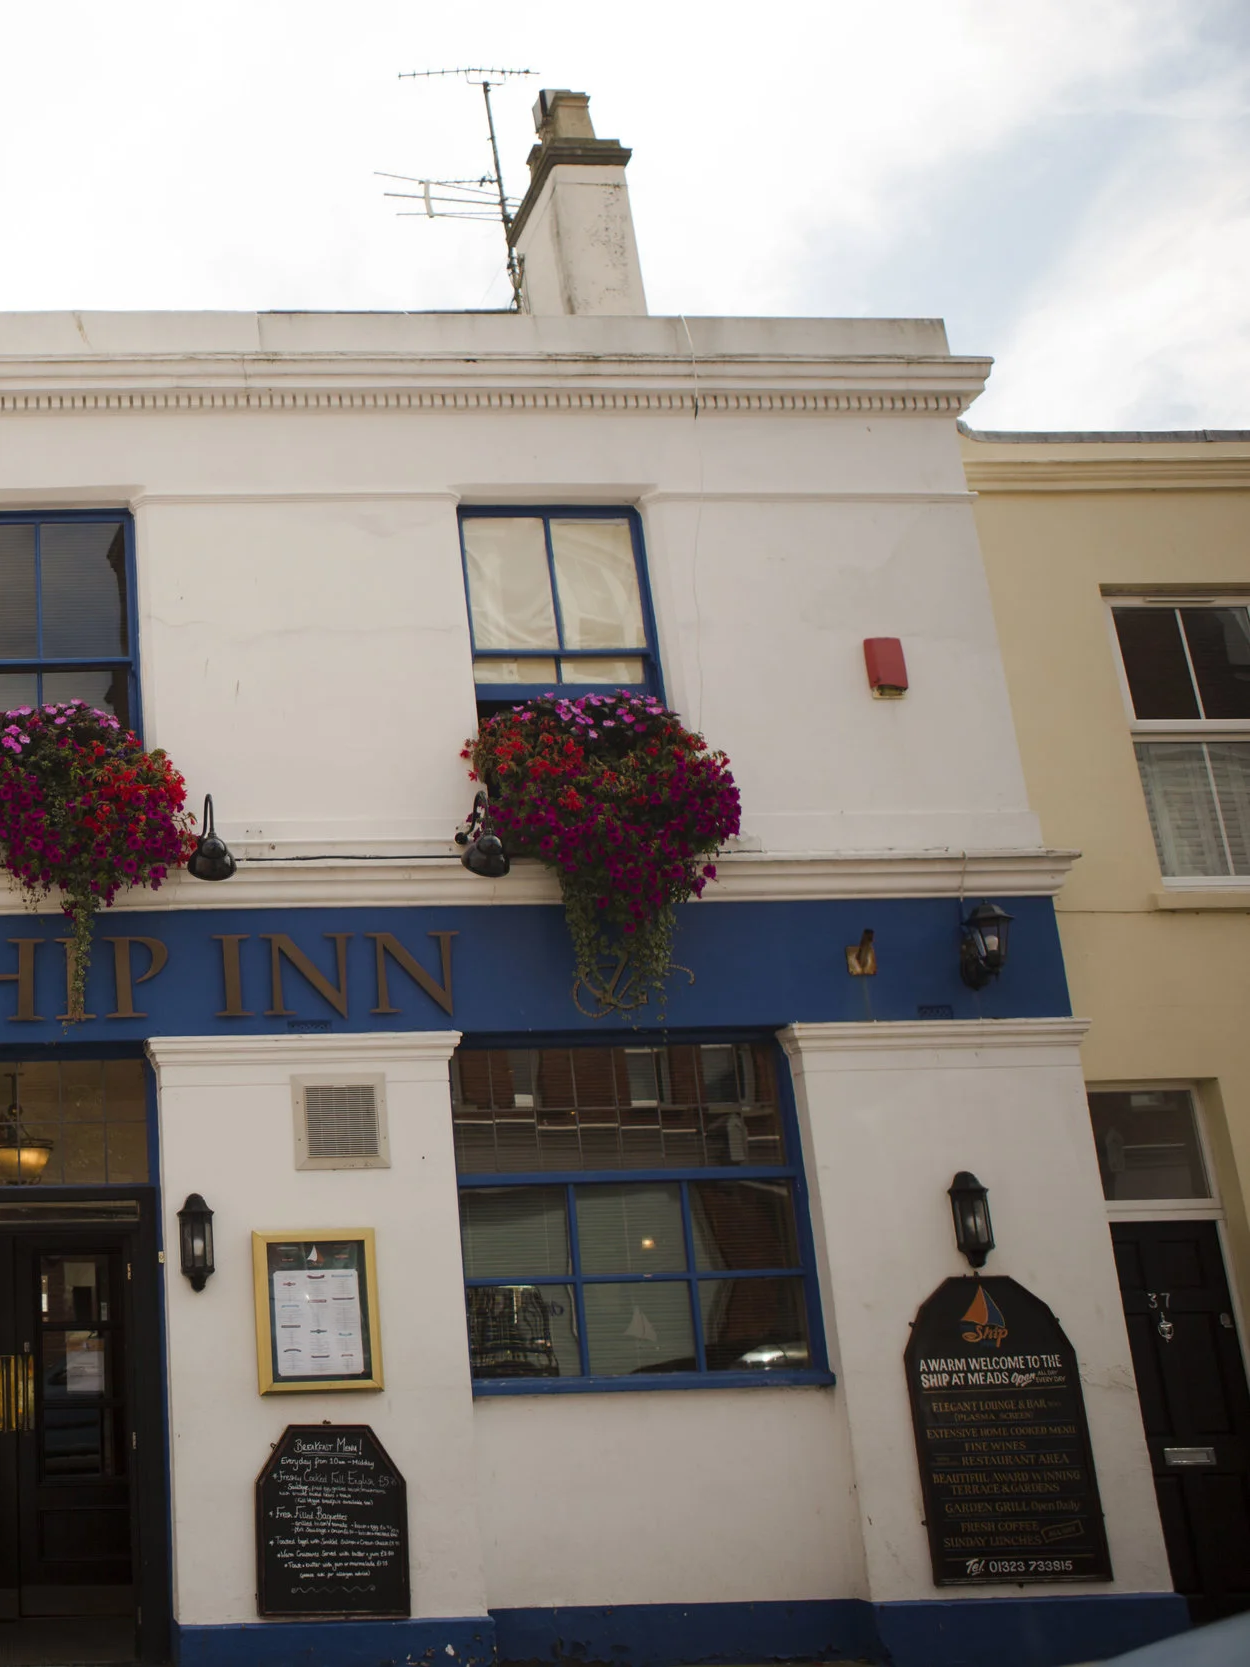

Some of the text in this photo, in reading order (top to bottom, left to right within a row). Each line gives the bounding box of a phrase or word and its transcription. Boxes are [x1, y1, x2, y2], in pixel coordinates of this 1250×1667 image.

[212, 930, 459, 1020] INN
[1148, 1292, 1170, 1309] 37
[962, 1325, 1008, 1348] Ship
[920, 1354, 1062, 1372] A WARM WELCOME TO THE
[920, 1372, 1036, 1388] SHIP AT MEADS Open
[932, 1401, 978, 1413] ELEGANT
[979, 1400, 1016, 1410] LOUNGE
[1018, 1400, 1025, 1410] &
[1026, 1399, 1046, 1409] BAR
[926, 1425, 1076, 1439] EXTENSIVE HOME COOKED MENU
[964, 1440, 1026, 1451] FINE WINES
[281, 1457, 311, 1471] Everyday
[314, 1458, 327, 1468] from
[962, 1454, 1036, 1466] RESTAURANT
[1038, 1453, 1070, 1464] AREA
[331, 1472, 345, 1484] Full
[932, 1470, 1081, 1484] BEAUTIFUL AWARD WINNING
[951, 1482, 1060, 1496] TERRACE & GARDENS
[945, 1500, 1080, 1514] GARDEN GRILL Open Daily
[960, 1521, 1039, 1533] FRESH COFFEE
[943, 1535, 1041, 1548] SUNDAY LUNCHES
[989, 1560, 1026, 1573] 01323
[1028, 1560, 1073, 1572] 733815
